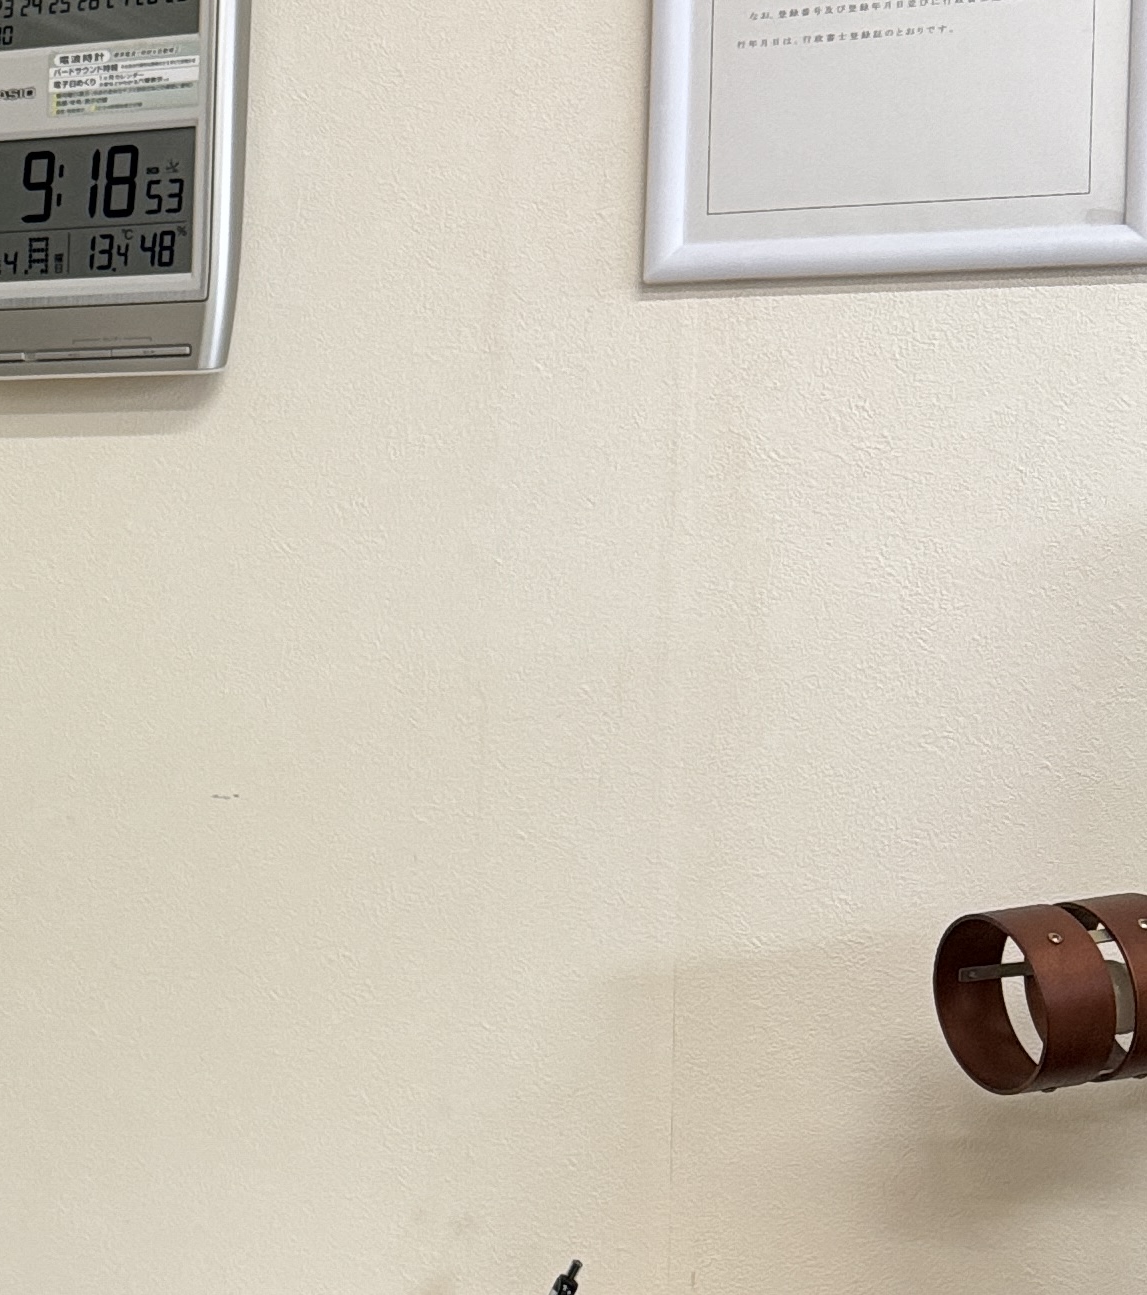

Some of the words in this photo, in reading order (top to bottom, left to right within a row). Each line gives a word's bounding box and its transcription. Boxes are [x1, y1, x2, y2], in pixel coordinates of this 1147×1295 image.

[21, 145, 140, 225] 9:18
[145, 179, 184, 214] 53
[90, 233, 131, 272] 13.4
[140, 230, 176, 267] 48
